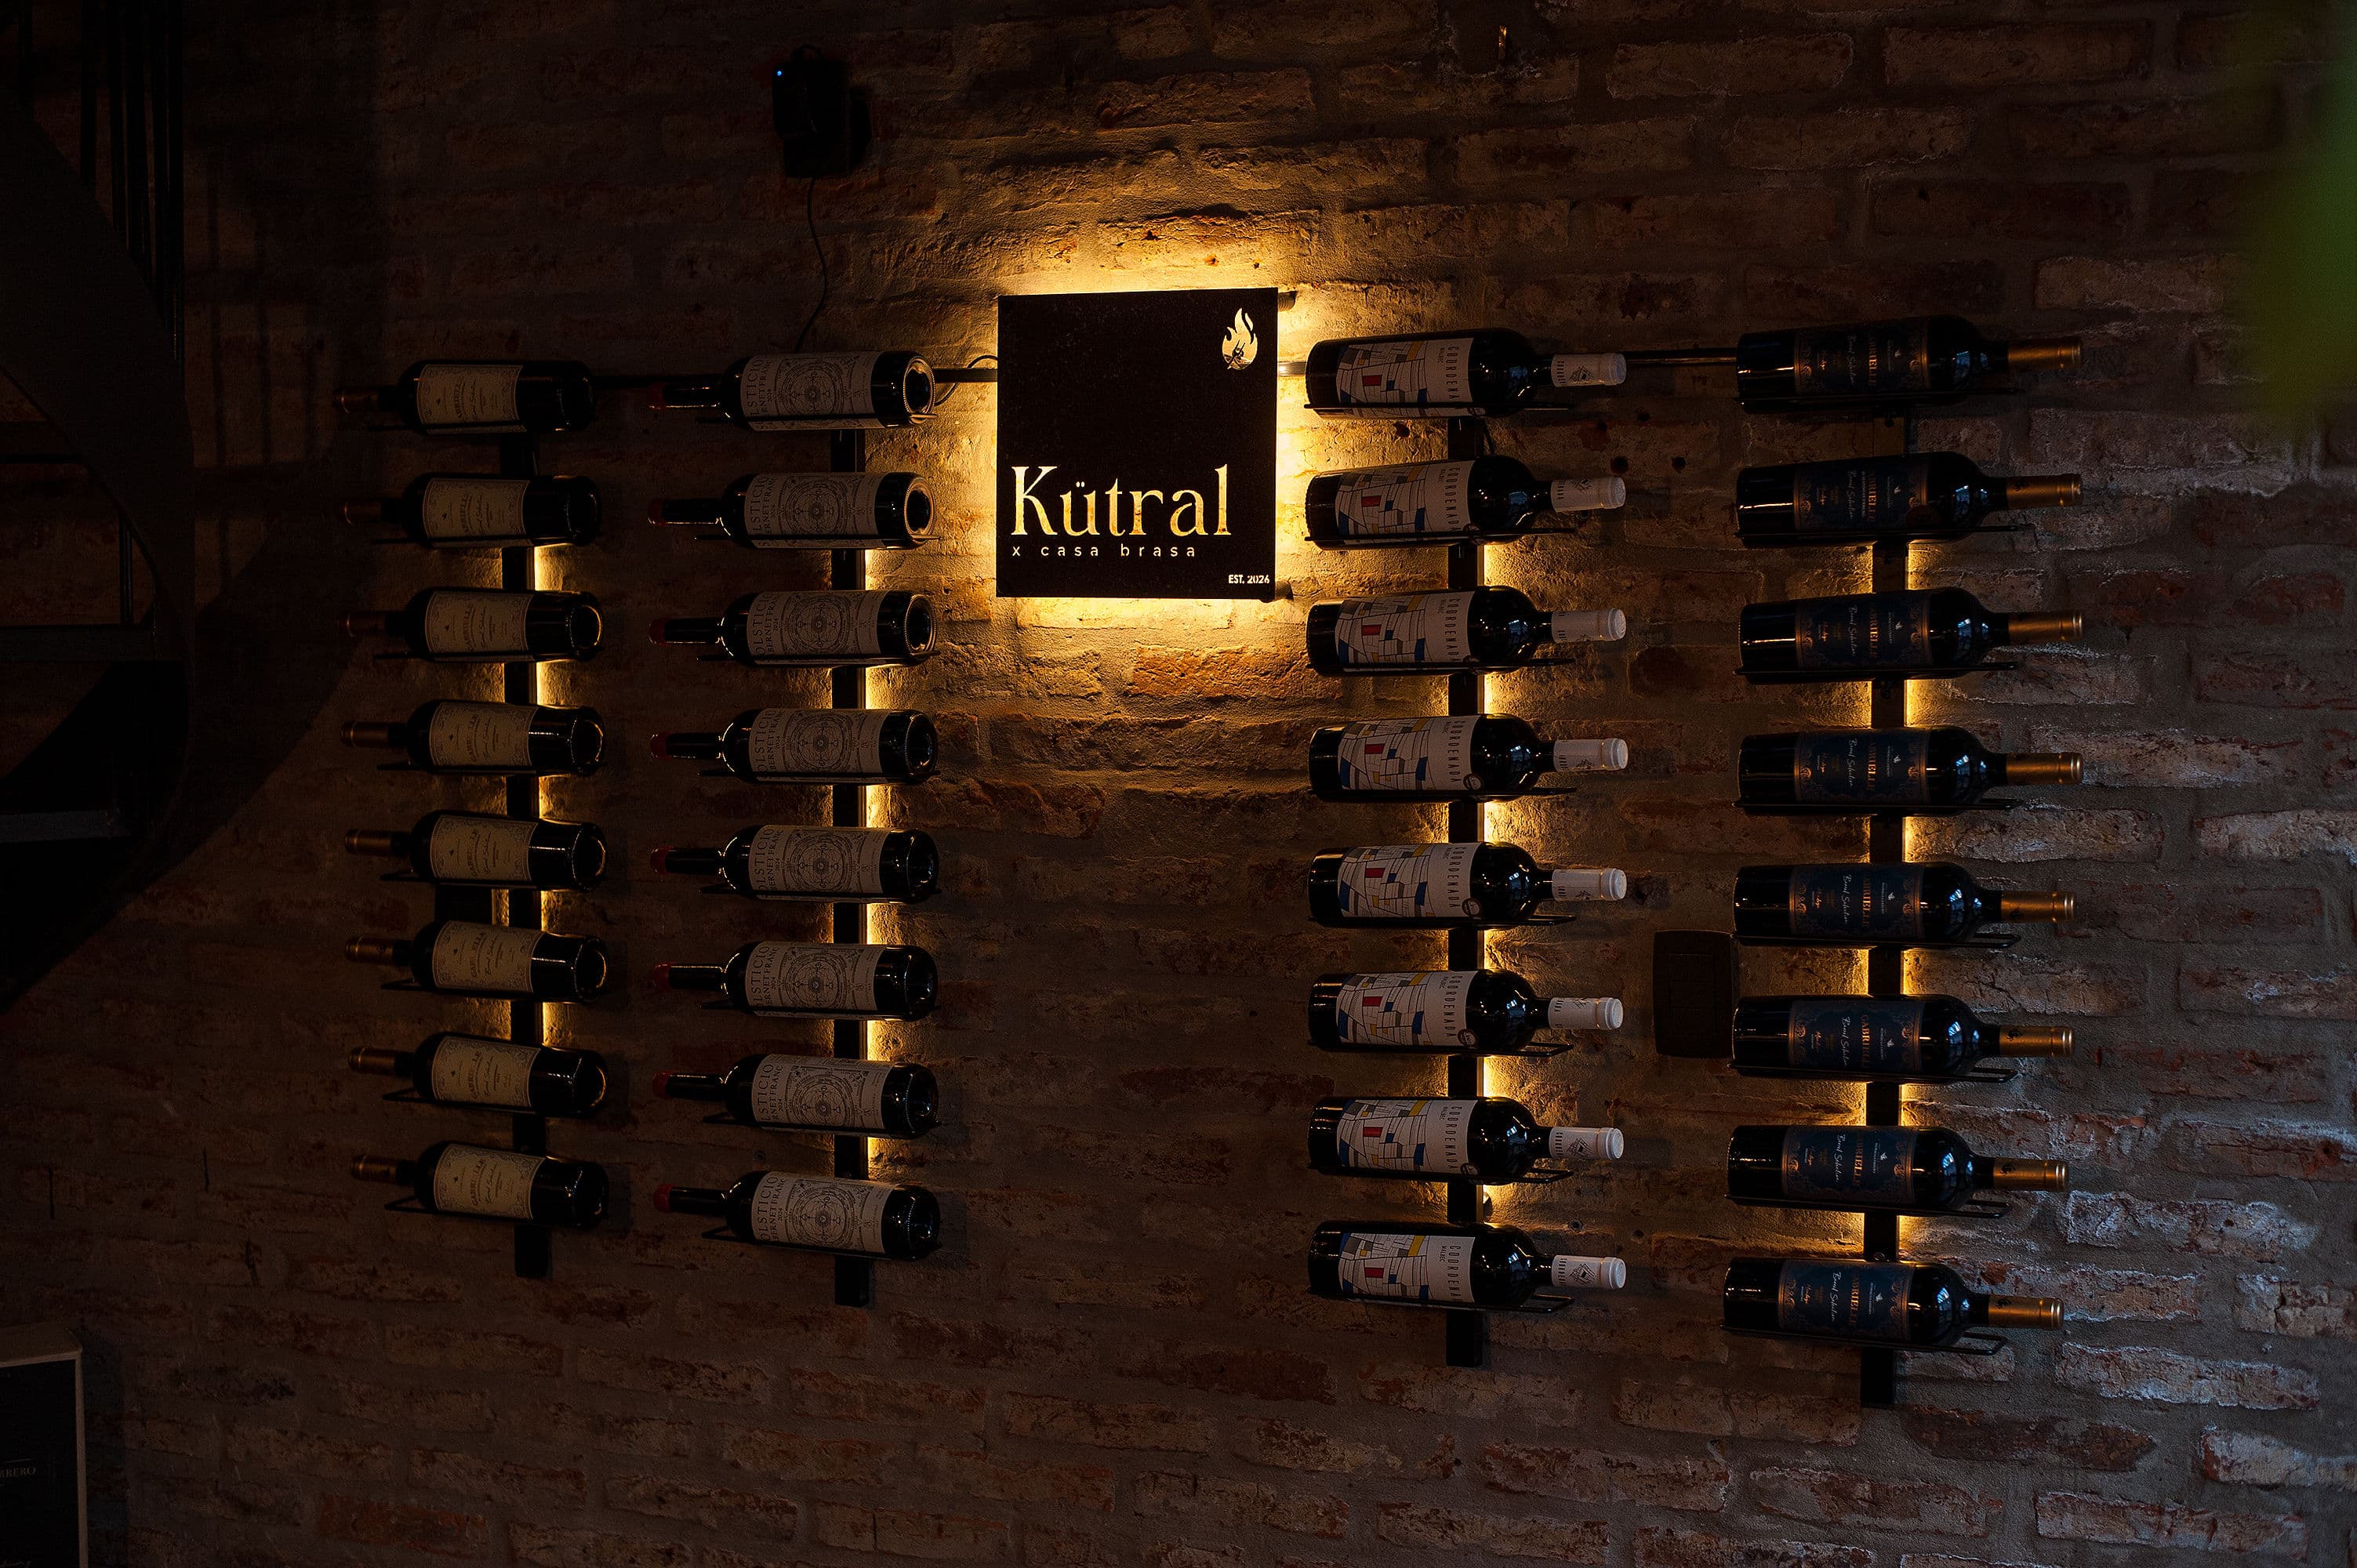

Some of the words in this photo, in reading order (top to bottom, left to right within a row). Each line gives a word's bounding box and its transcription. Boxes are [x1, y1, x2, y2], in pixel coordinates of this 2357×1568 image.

[746, 359, 764, 416] LSTICIO
[1446, 347, 1460, 399] COORDENA
[750, 477, 769, 532] LSTICIO
[762, 504, 772, 533] ERNET
[1011, 463, 1232, 537] Kütral
[1011, 546, 1021, 557] x
[1040, 546, 1099, 557] casa
[1120, 543, 1196, 557] brasa
[1228, 574, 1245, 584] EST.
[1247, 574, 1270, 584] 2026
[753, 594, 772, 655] OLSTICIO
[765, 617, 775, 652] BERNET
[754, 709, 775, 772] OLSTICIO
[768, 734, 777, 770] BERNET
[754, 829, 775, 891] OLSTICIO
[750, 946, 770, 1004] LSTICIO
[763, 974, 773, 1004] ERNET
[757, 1065, 774, 1122] LSTICIO
[769, 1098, 779, 1121] RNET
[757, 1177, 779, 1242] OLSTICIO
[770, 1207, 779, 1240] BERNET
[1447, 1245, 1463, 1301] COORDENA
